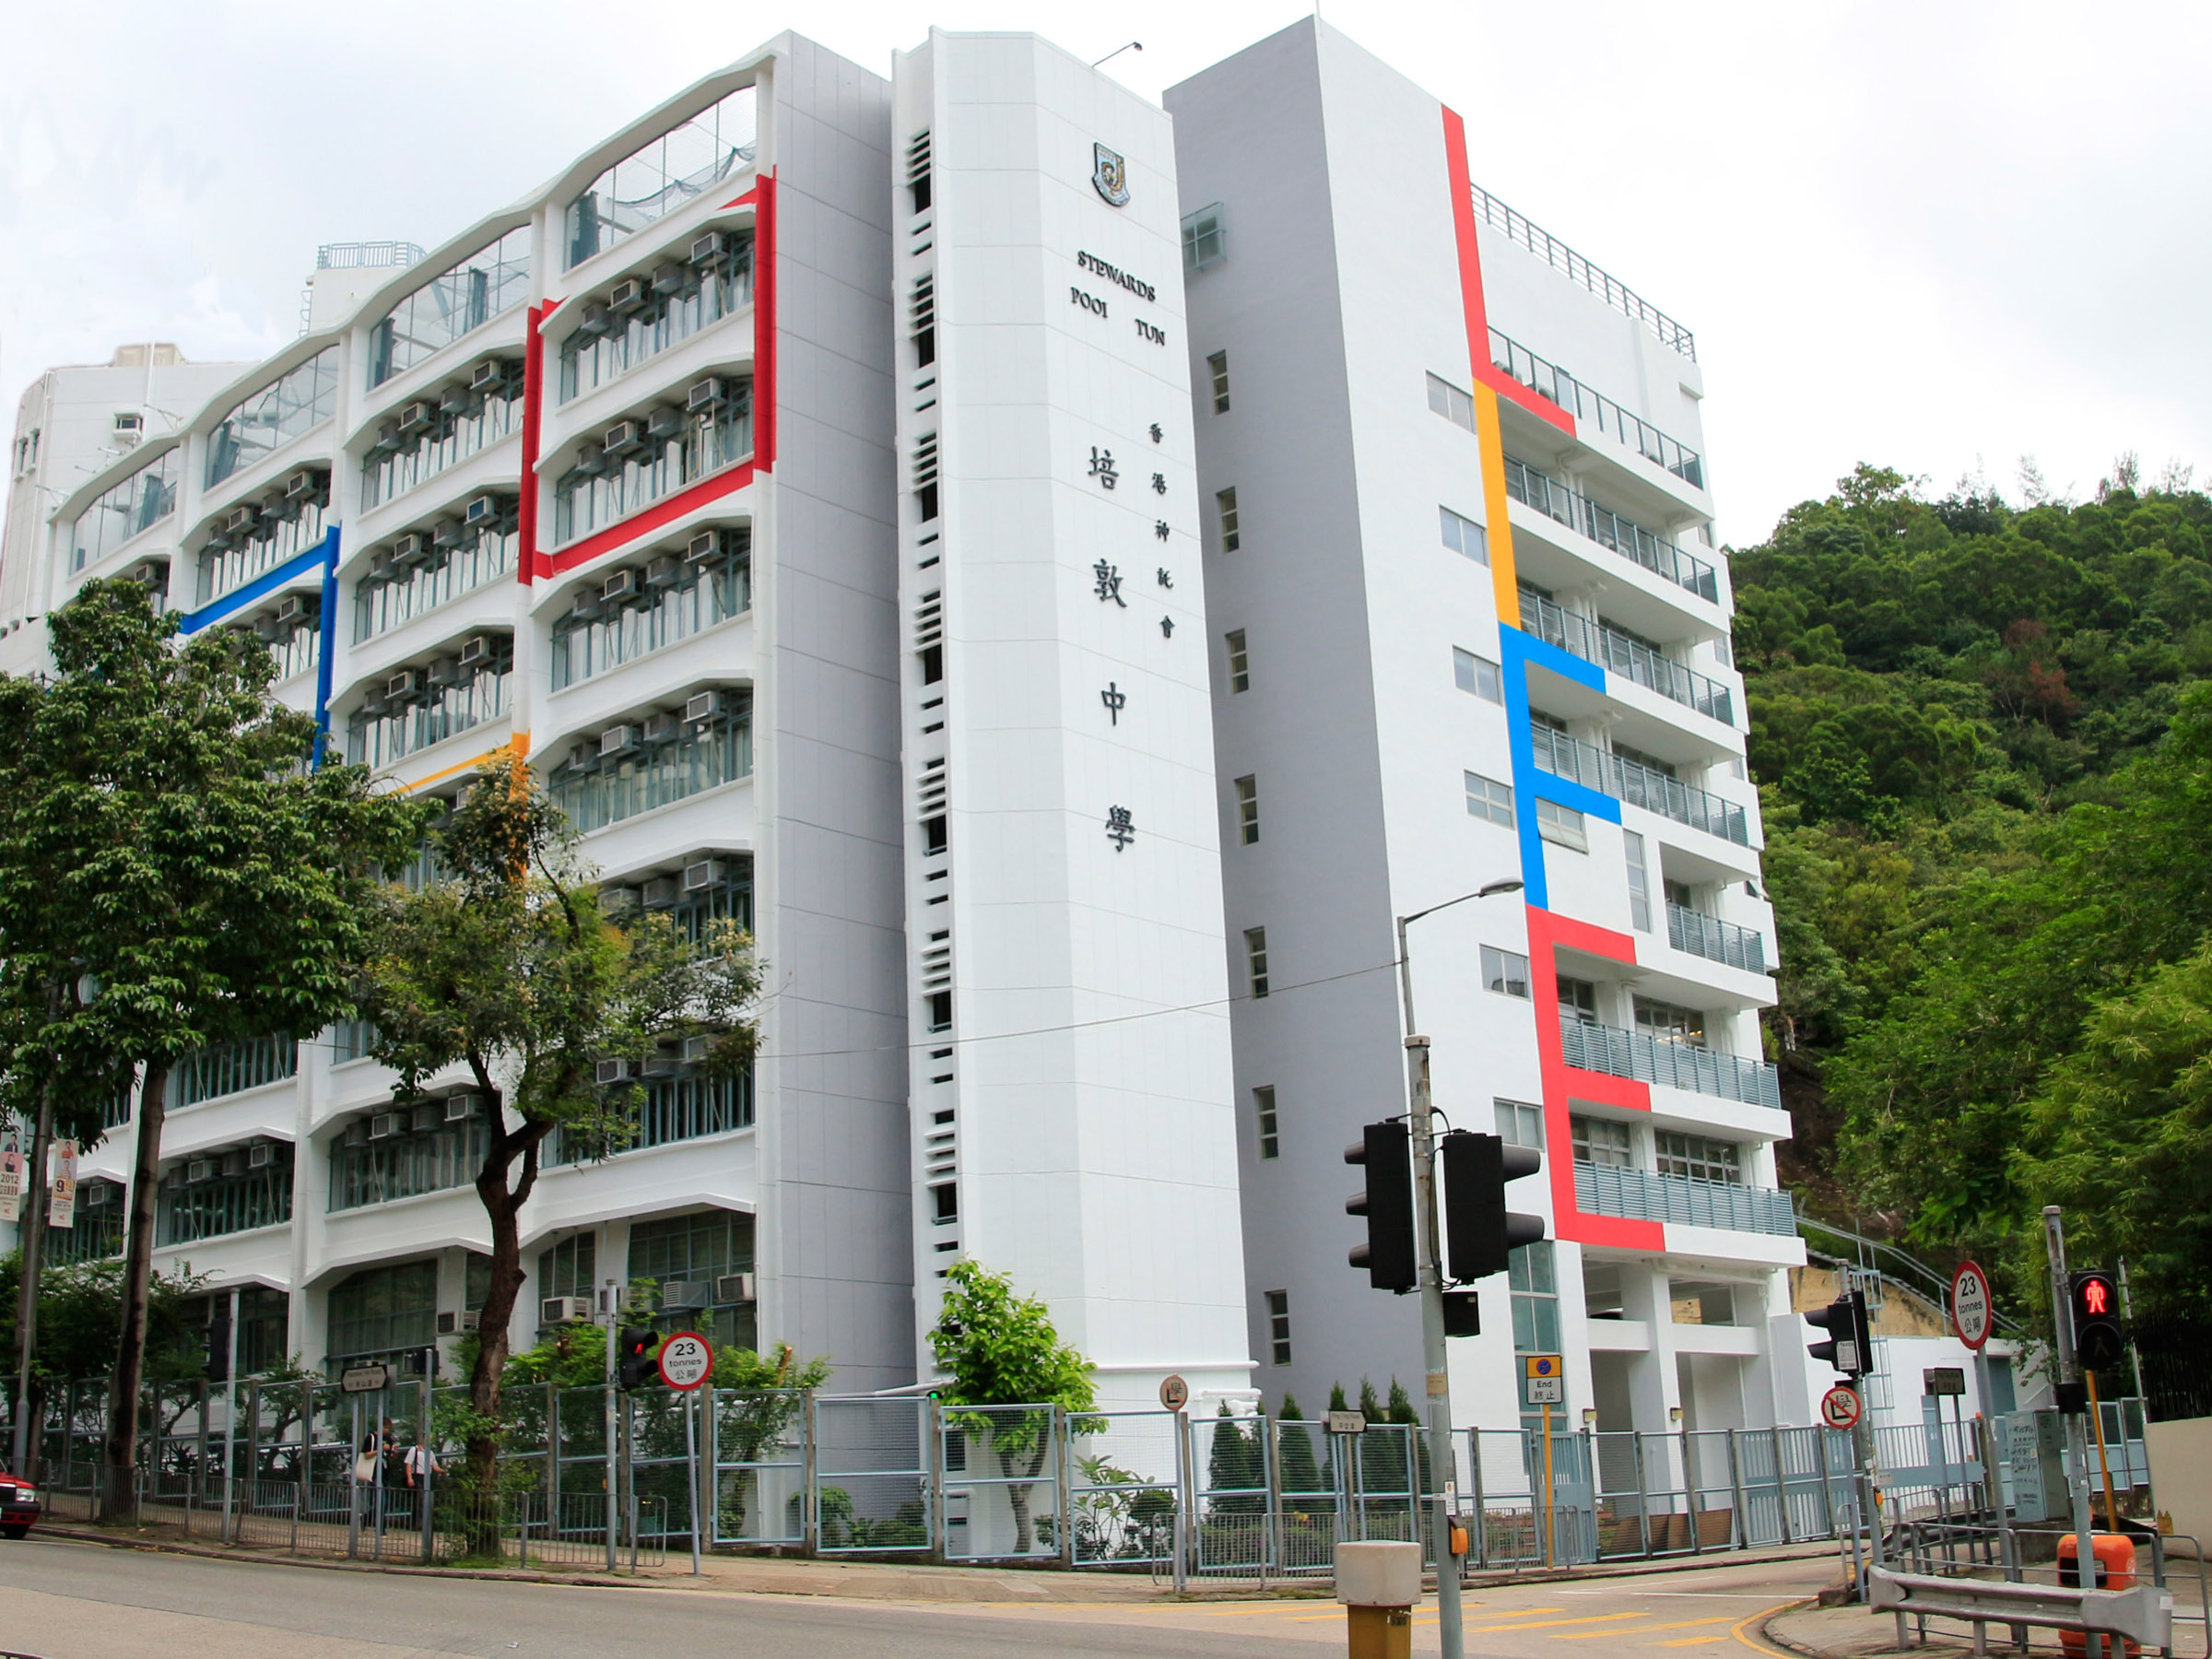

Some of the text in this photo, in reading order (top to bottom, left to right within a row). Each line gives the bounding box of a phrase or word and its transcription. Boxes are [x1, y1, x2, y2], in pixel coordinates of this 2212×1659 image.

[1077, 250, 1156, 302] STEWARDS
[1070, 286, 1165, 347] POOI TUN
[1088, 446, 1136, 853] 培敦中學
[1, 1173, 19, 1184] 2012
[1959, 1276, 1976, 1297] 23
[1958, 1300, 1983, 1315] tonnes
[675, 1342, 696, 1356] 23
[669, 1359, 702, 1368] tonnes
[1534, 1391, 1555, 1400] 終止
